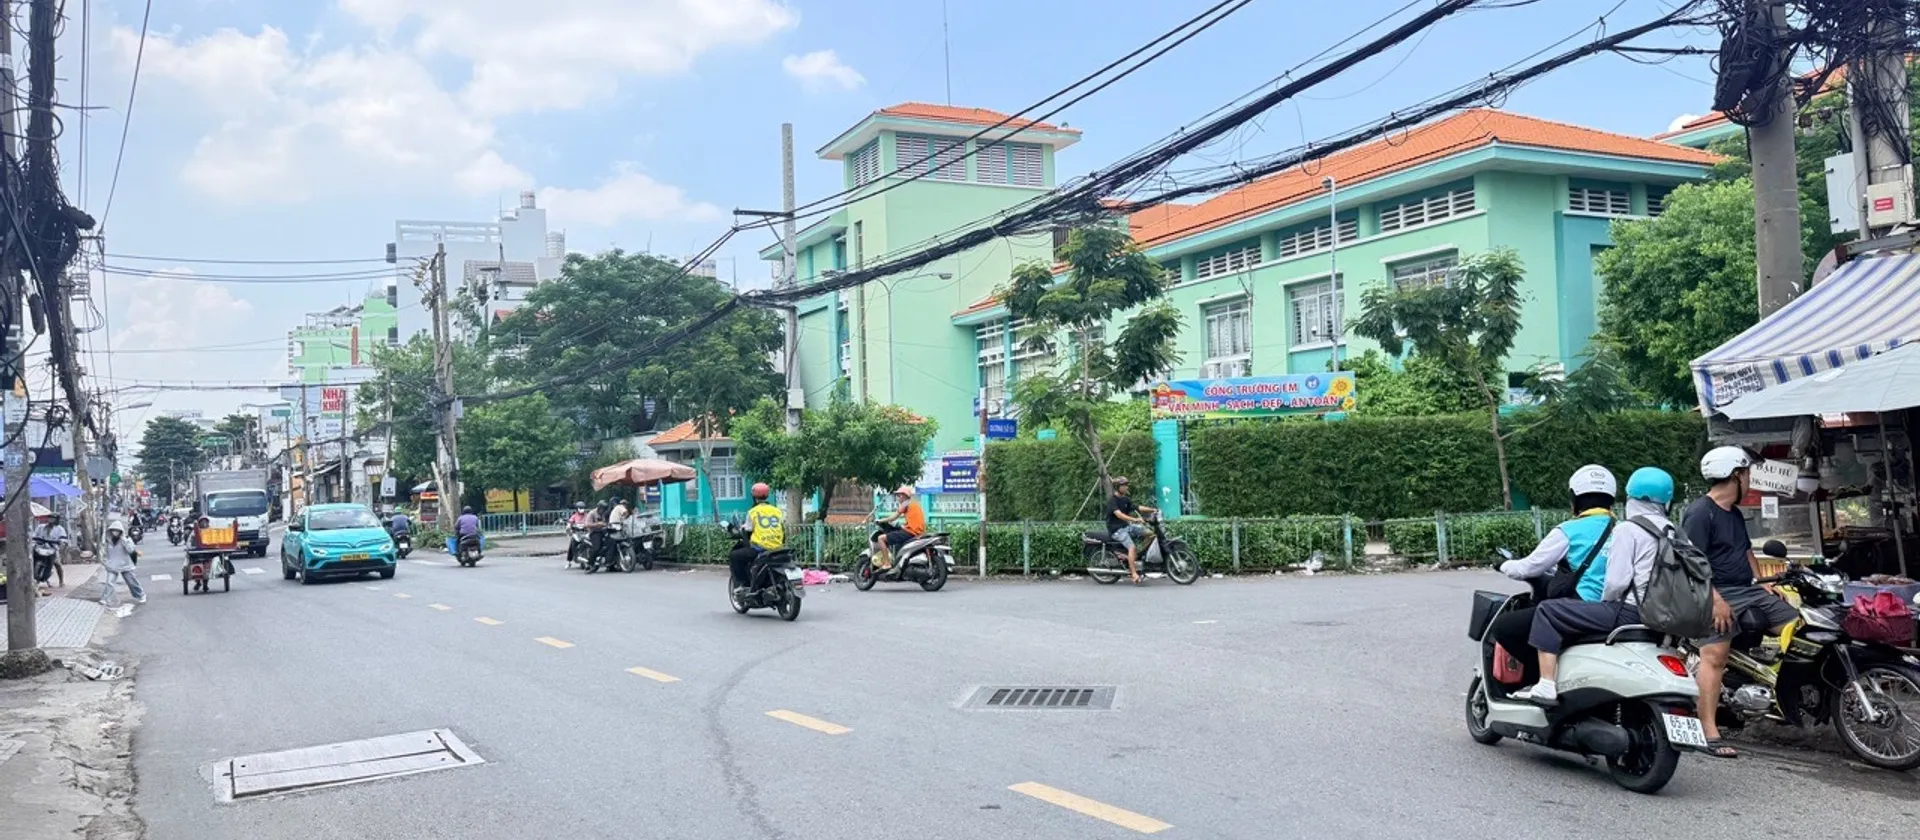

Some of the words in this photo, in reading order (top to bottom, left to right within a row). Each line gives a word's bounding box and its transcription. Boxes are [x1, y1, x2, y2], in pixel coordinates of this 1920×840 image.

[1282, 383, 1297, 392] EM
[1192, 401, 1219, 412] MINH
[1291, 397, 1306, 407] AN
[756, 512, 780, 529] be
[1671, 729, 1705, 745] 450.84
